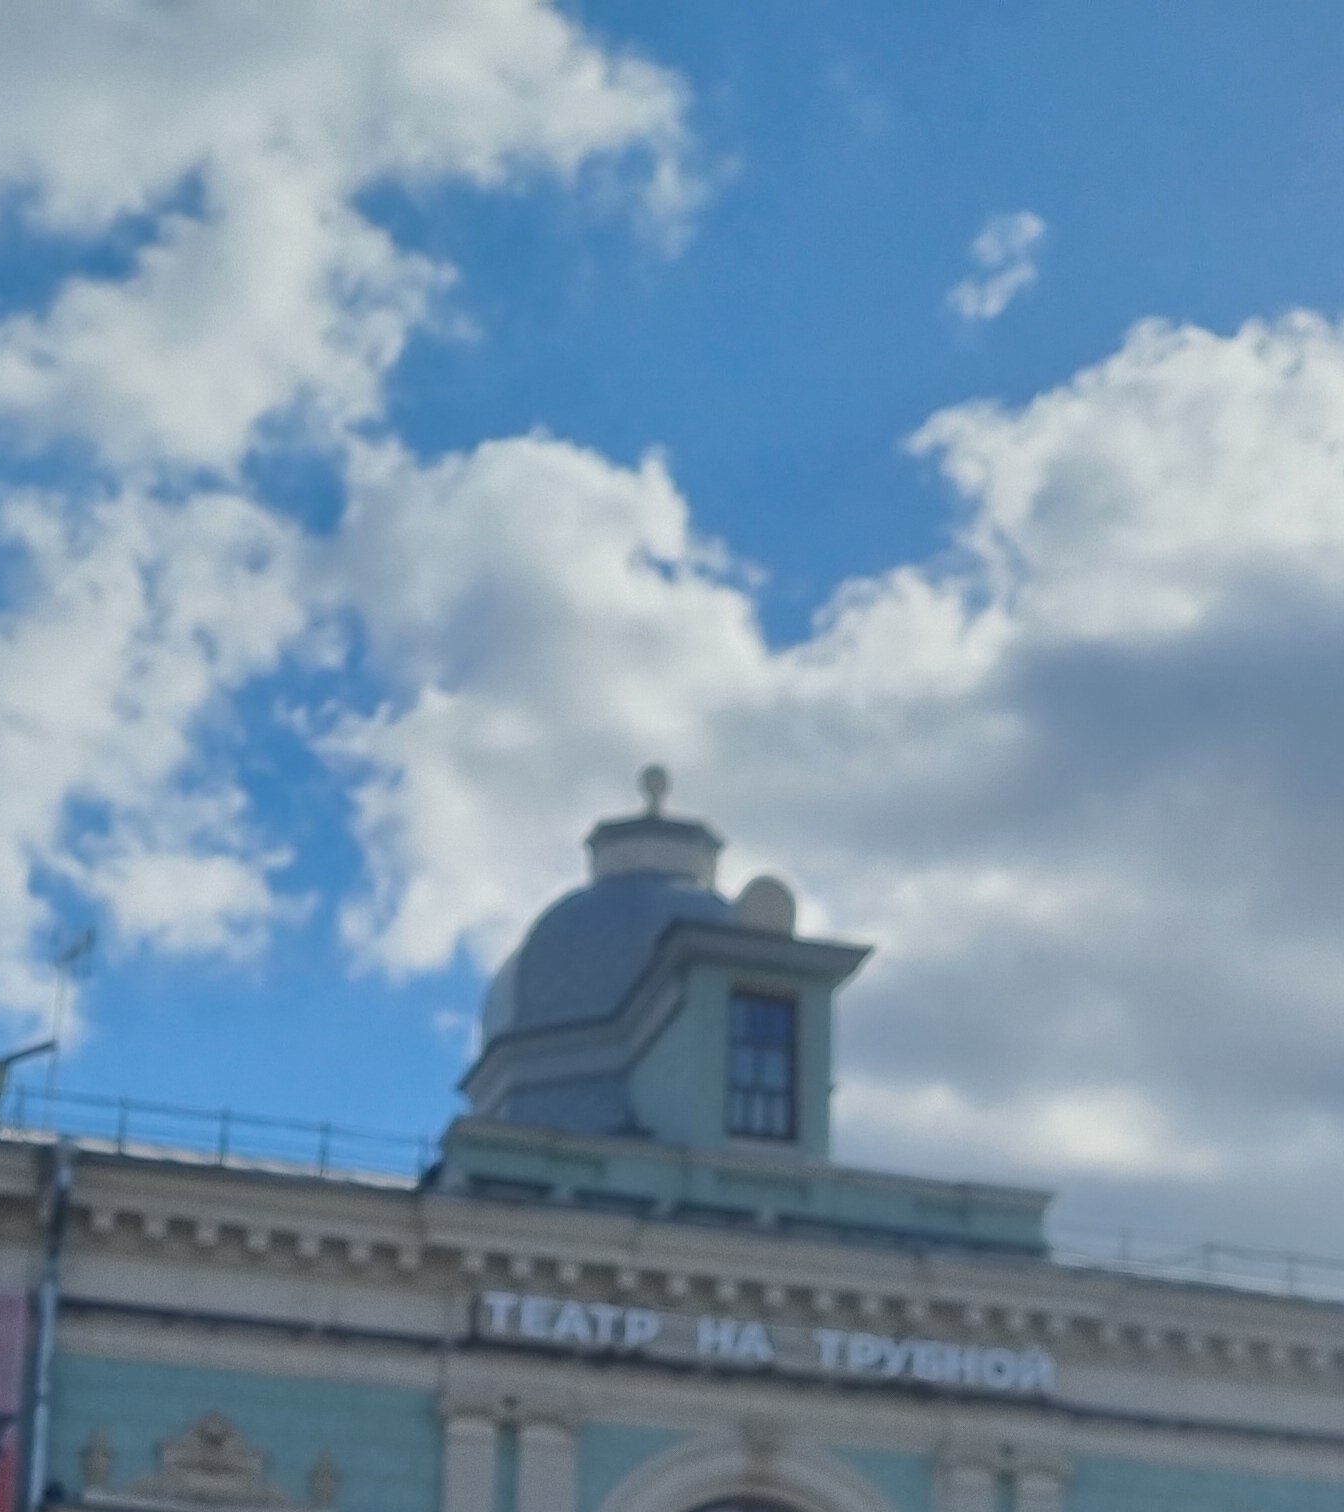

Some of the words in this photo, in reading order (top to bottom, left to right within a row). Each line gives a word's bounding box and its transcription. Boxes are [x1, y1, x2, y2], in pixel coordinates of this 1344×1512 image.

[483, 1291, 657, 1347] ТЕАТР
[697, 1314, 775, 1363] НА
[814, 1329, 1056, 1394] ТРУБНОЙ
